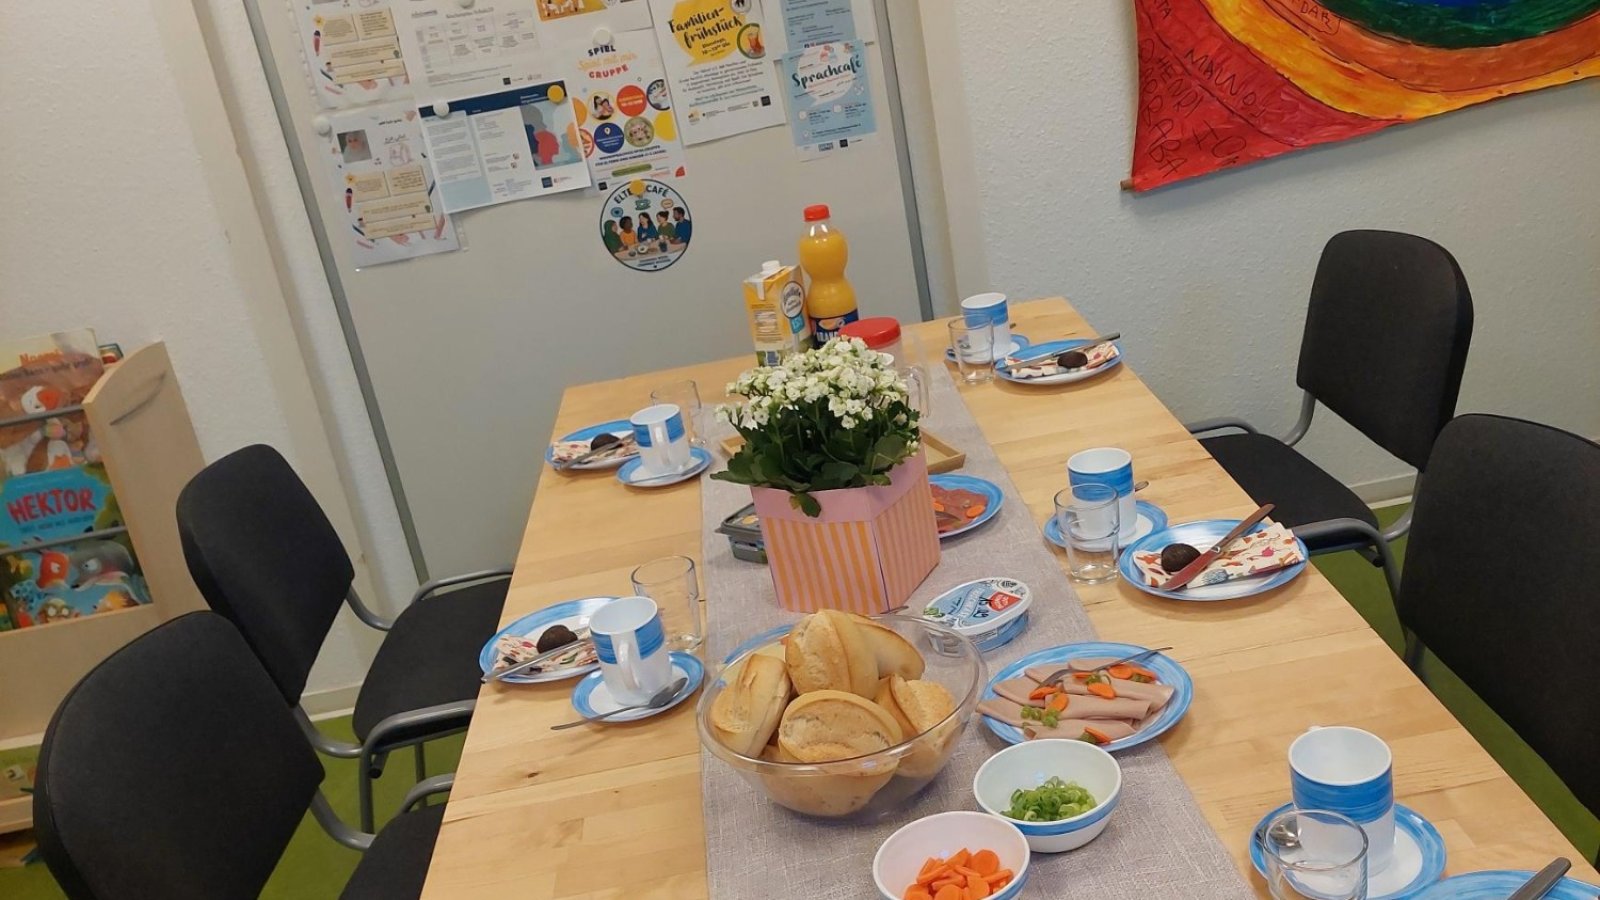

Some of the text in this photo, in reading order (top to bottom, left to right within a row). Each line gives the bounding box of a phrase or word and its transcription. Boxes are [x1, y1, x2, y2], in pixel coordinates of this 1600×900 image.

[668, 7, 725, 33] Familien-
[683, 16, 743, 48] frühstück
[587, 44, 617, 57] SPIEL
[588, 64, 629, 79] GRUPPE
[792, 54, 862, 89] Sprachcafé
[645, 184, 671, 197] CAFÉ
[6, 488, 96, 524] HEKTOR
